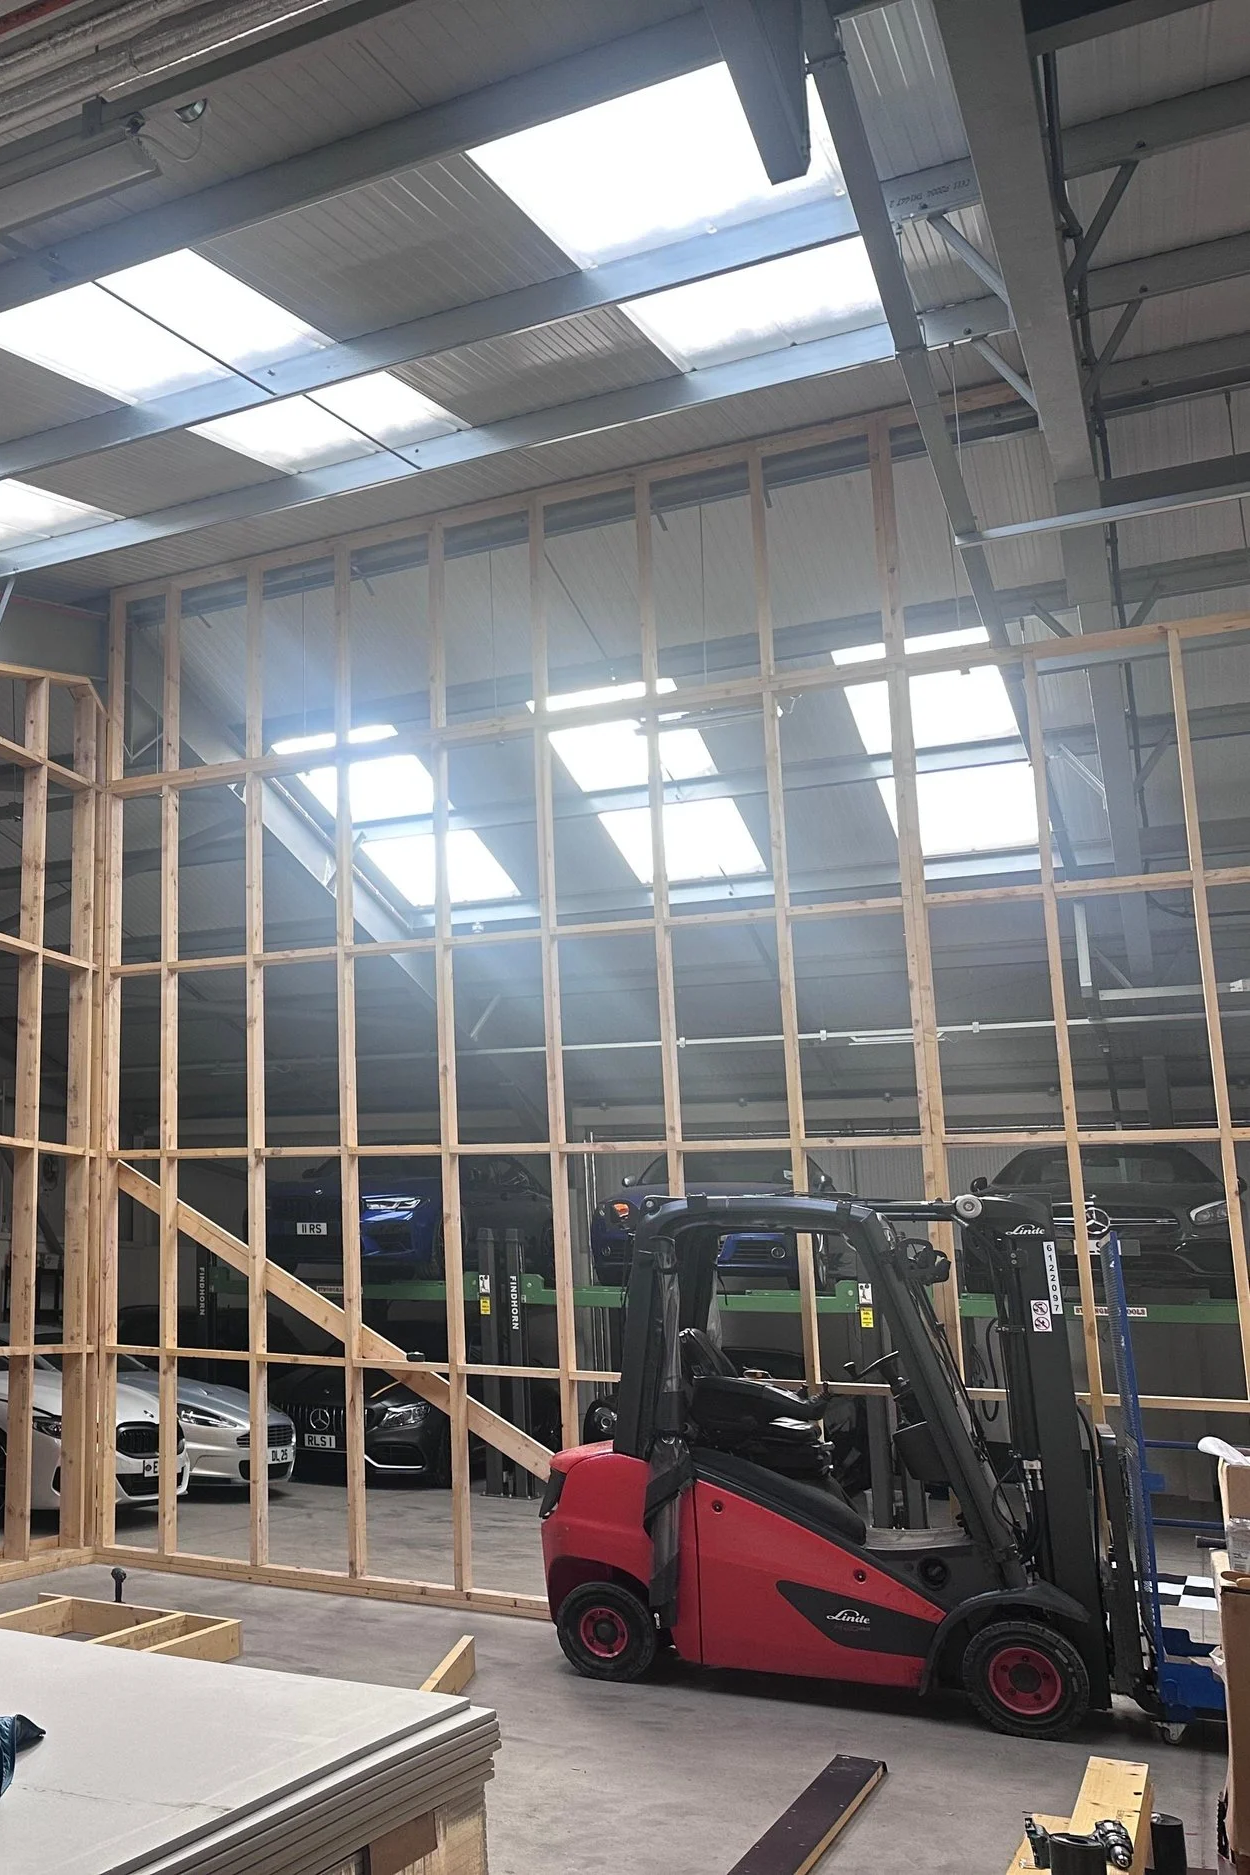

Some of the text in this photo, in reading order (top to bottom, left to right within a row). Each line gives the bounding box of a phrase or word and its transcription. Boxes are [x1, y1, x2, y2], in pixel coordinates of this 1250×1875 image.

[309, 1224, 322, 1233] RS
[1005, 1223, 1045, 1235] Linde
[1046, 1244, 1059, 1311] 6122097
[510, 1275, 519, 1330] FINDHORN
[308, 1435, 327, 1446] RLS
[281, 1449, 288, 1460] 25
[826, 1609, 871, 1624] Linde
